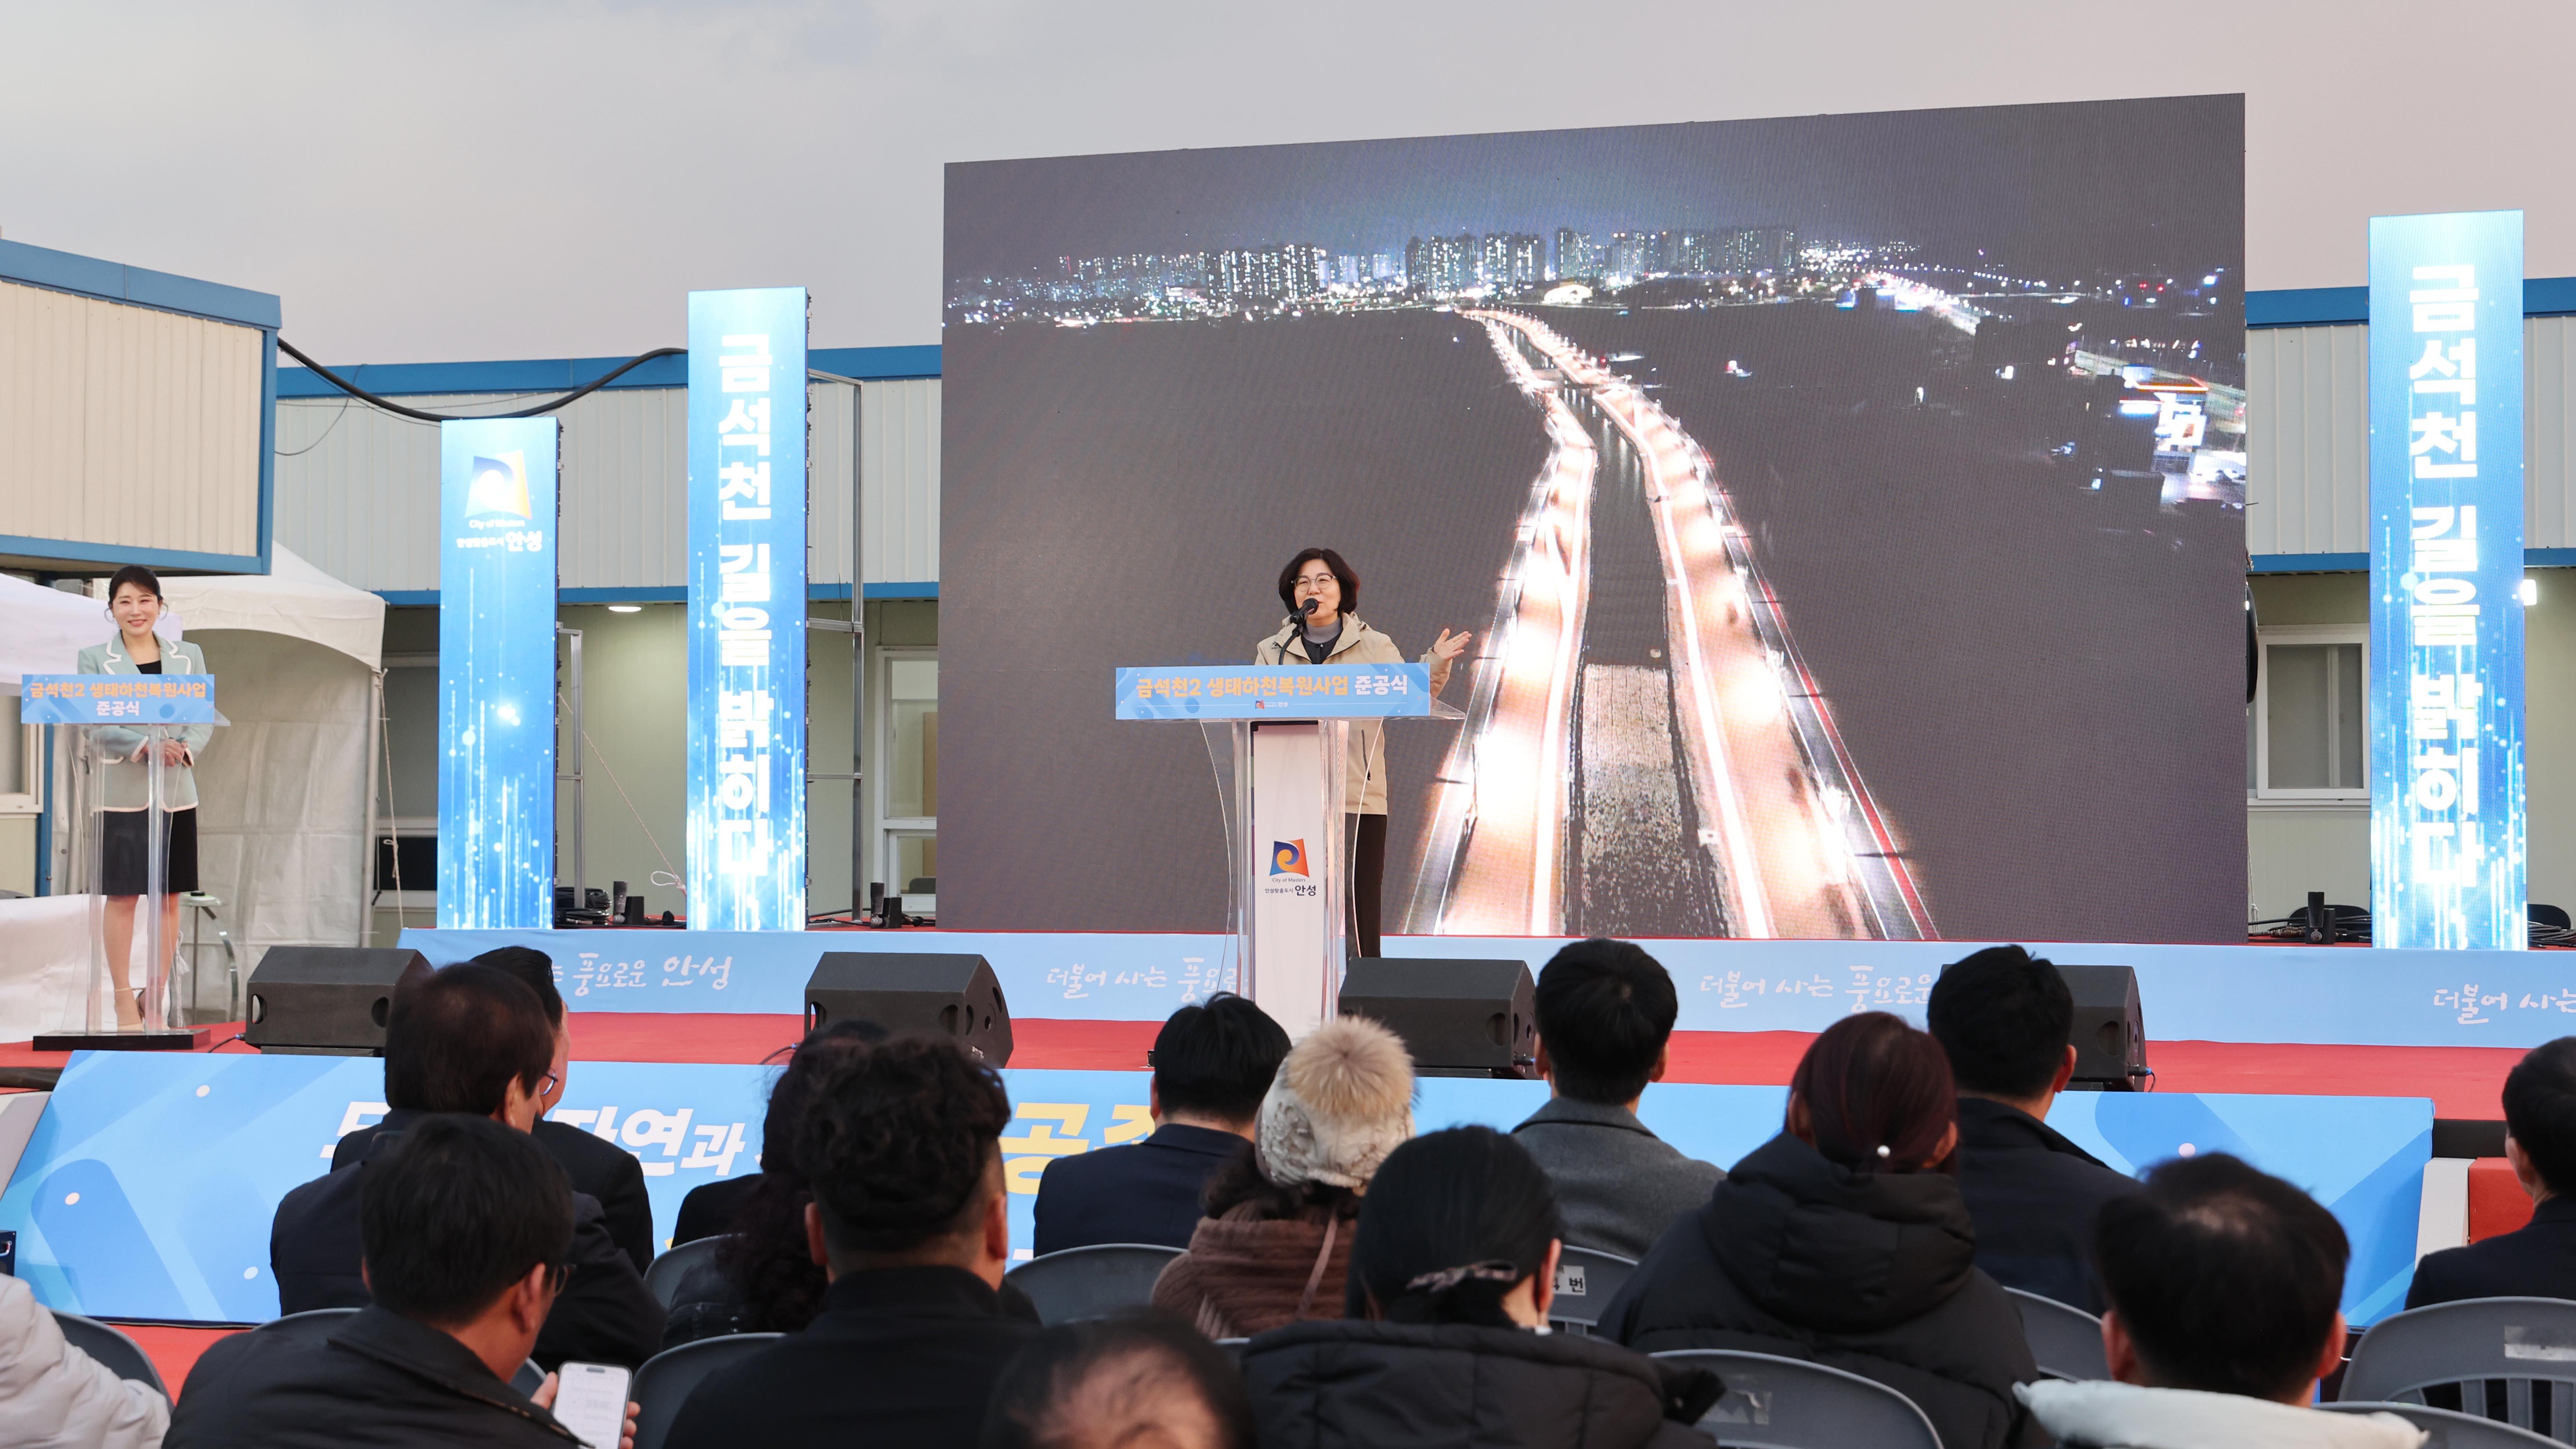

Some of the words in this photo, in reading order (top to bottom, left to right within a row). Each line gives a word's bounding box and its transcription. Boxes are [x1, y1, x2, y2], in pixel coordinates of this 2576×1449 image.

[2410, 264, 2479, 478] 금석천
[719, 334, 772, 520] 금석천
[506, 530, 542, 551] 안성
[2410, 505, 2480, 645] 길을
[719, 544, 772, 666] 길을
[30, 683, 85, 698] 금석천2
[90, 683, 206, 698] 생태하천복원사업
[1136, 678, 1201, 697] 금석천2
[1207, 675, 1348, 696] 생태하천복원사업
[1355, 674, 1408, 695] 준공식
[96, 701, 140, 716] 준공식
[719, 690, 774, 876] 밝히다
[2412, 673, 2484, 887] 밝히다
[1295, 885, 1316, 896] 안성
[573, 953, 647, 996] 풍요로운
[662, 955, 733, 990] 안성
[1047, 964, 1107, 999] 더불어
[1114, 966, 1168, 988] 사는
[1700, 971, 1766, 1008] 더불어
[1775, 974, 1833, 997] 사는
[1845, 965, 1932, 1013] 풍요로운
[2433, 984, 2508, 1024] 더불어
[1569, 1277, 1583, 1292] 번
